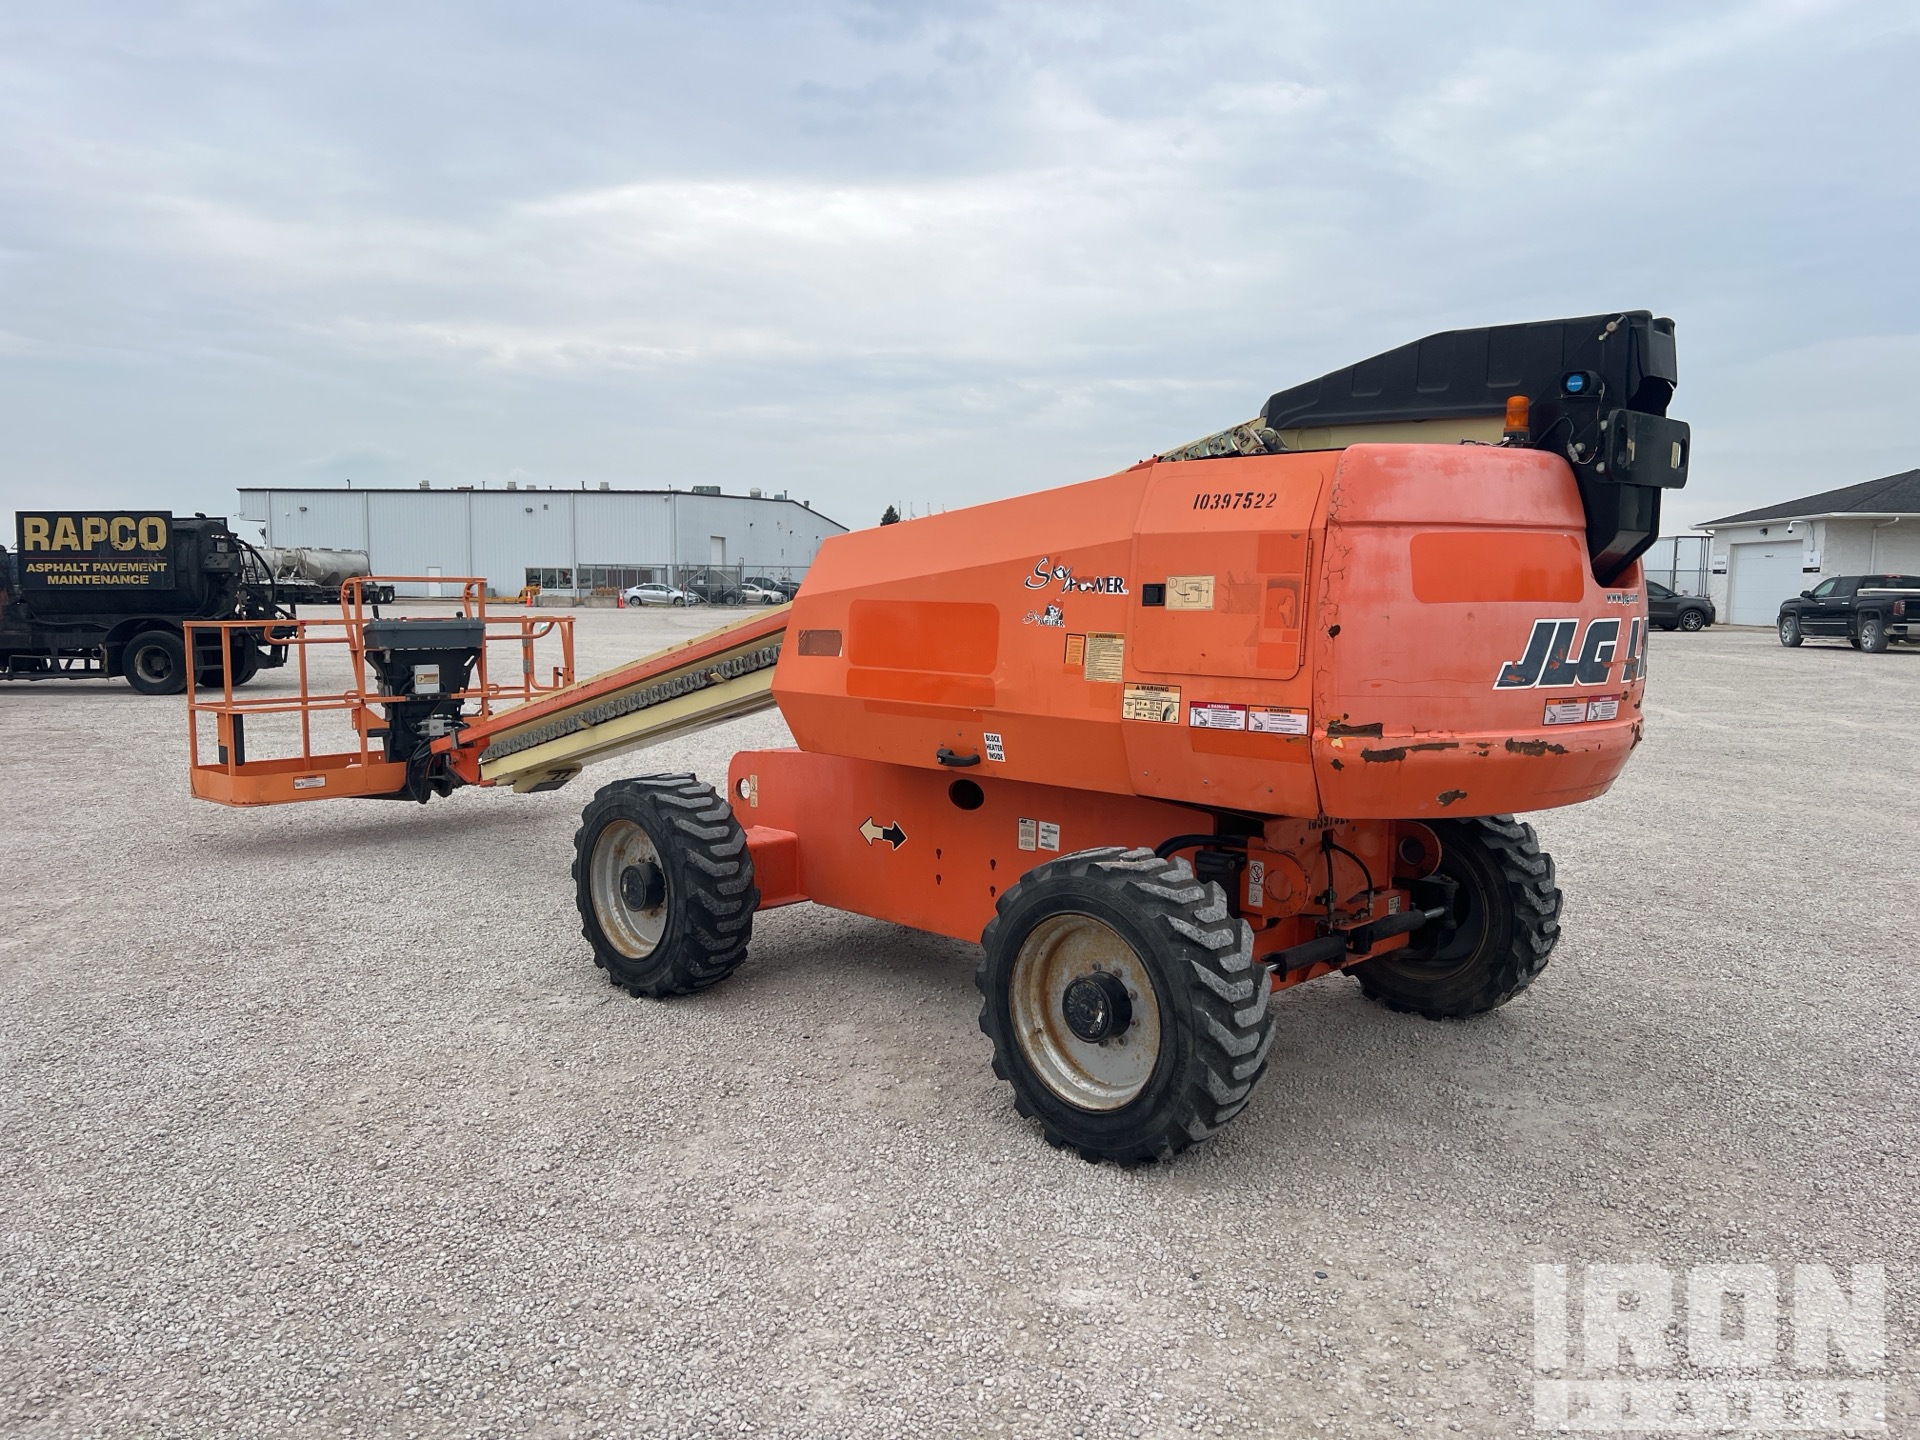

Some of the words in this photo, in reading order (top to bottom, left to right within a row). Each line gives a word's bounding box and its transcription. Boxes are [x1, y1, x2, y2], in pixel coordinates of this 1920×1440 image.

[1193, 492, 1277, 510] 10397522
[23, 516, 167, 551] RAPCO
[26, 563, 89, 573] ASPHALT
[92, 563, 167, 572] PAVEMENT
[47, 575, 149, 585] MAINTENANCE
[1492, 618, 1621, 690] JLG
[986, 735, 1000, 743] BLOCK
[989, 752, 1004, 761] INSIDE
